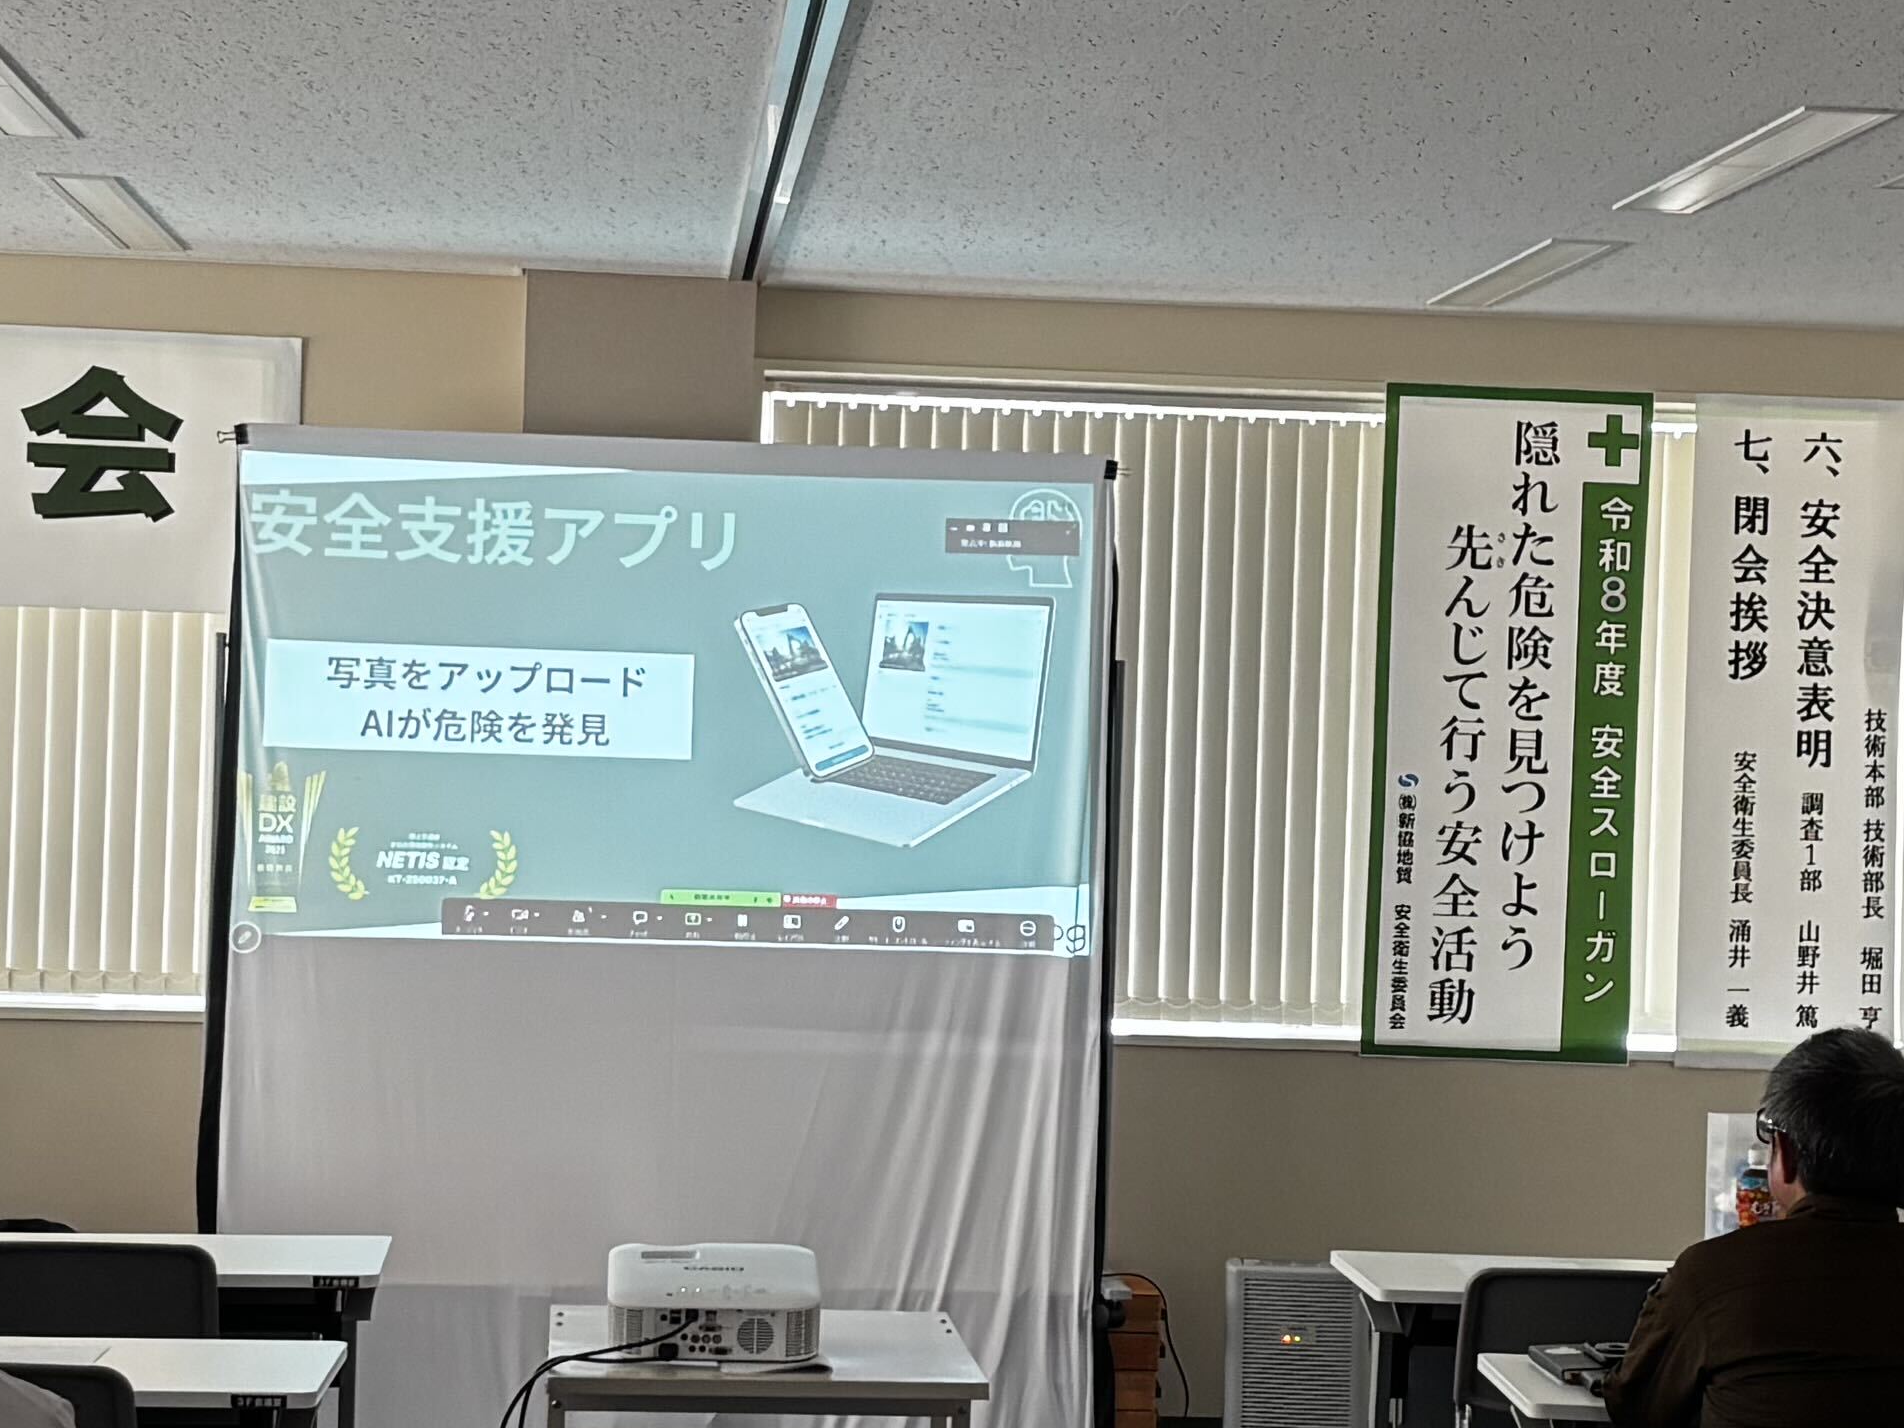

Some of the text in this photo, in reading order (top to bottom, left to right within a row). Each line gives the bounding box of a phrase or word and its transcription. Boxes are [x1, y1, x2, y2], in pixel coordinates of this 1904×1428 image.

[250, 489, 738, 572] 安全支援アプリ
[326, 656, 646, 698] 写真をアップロード
[360, 707, 610, 747] AIが危険を発見
[1497, 420, 1561, 971] 隠れた危険を見つけよう
[1426, 523, 1494, 1025] 先んじて行う安全活動
[1584, 496, 1634, 1002] 令和8年度 安全スローガン
[1725, 428, 1773, 1029] 七、閉会挨拶 安全衛生委員長 涌井 一義
[1795, 431, 1843, 1029] 六、安全決意表明 調査1部 山野井 篤
[1864, 708, 1888, 809] 技術本部
[258, 813, 294, 834] DX
[376, 850, 441, 870] NETIS
[1861, 818, 1886, 920] 技術部長
[1388, 903, 1412, 1030] 安全衛生委員会
[1860, 946, 1884, 995] 堀田
